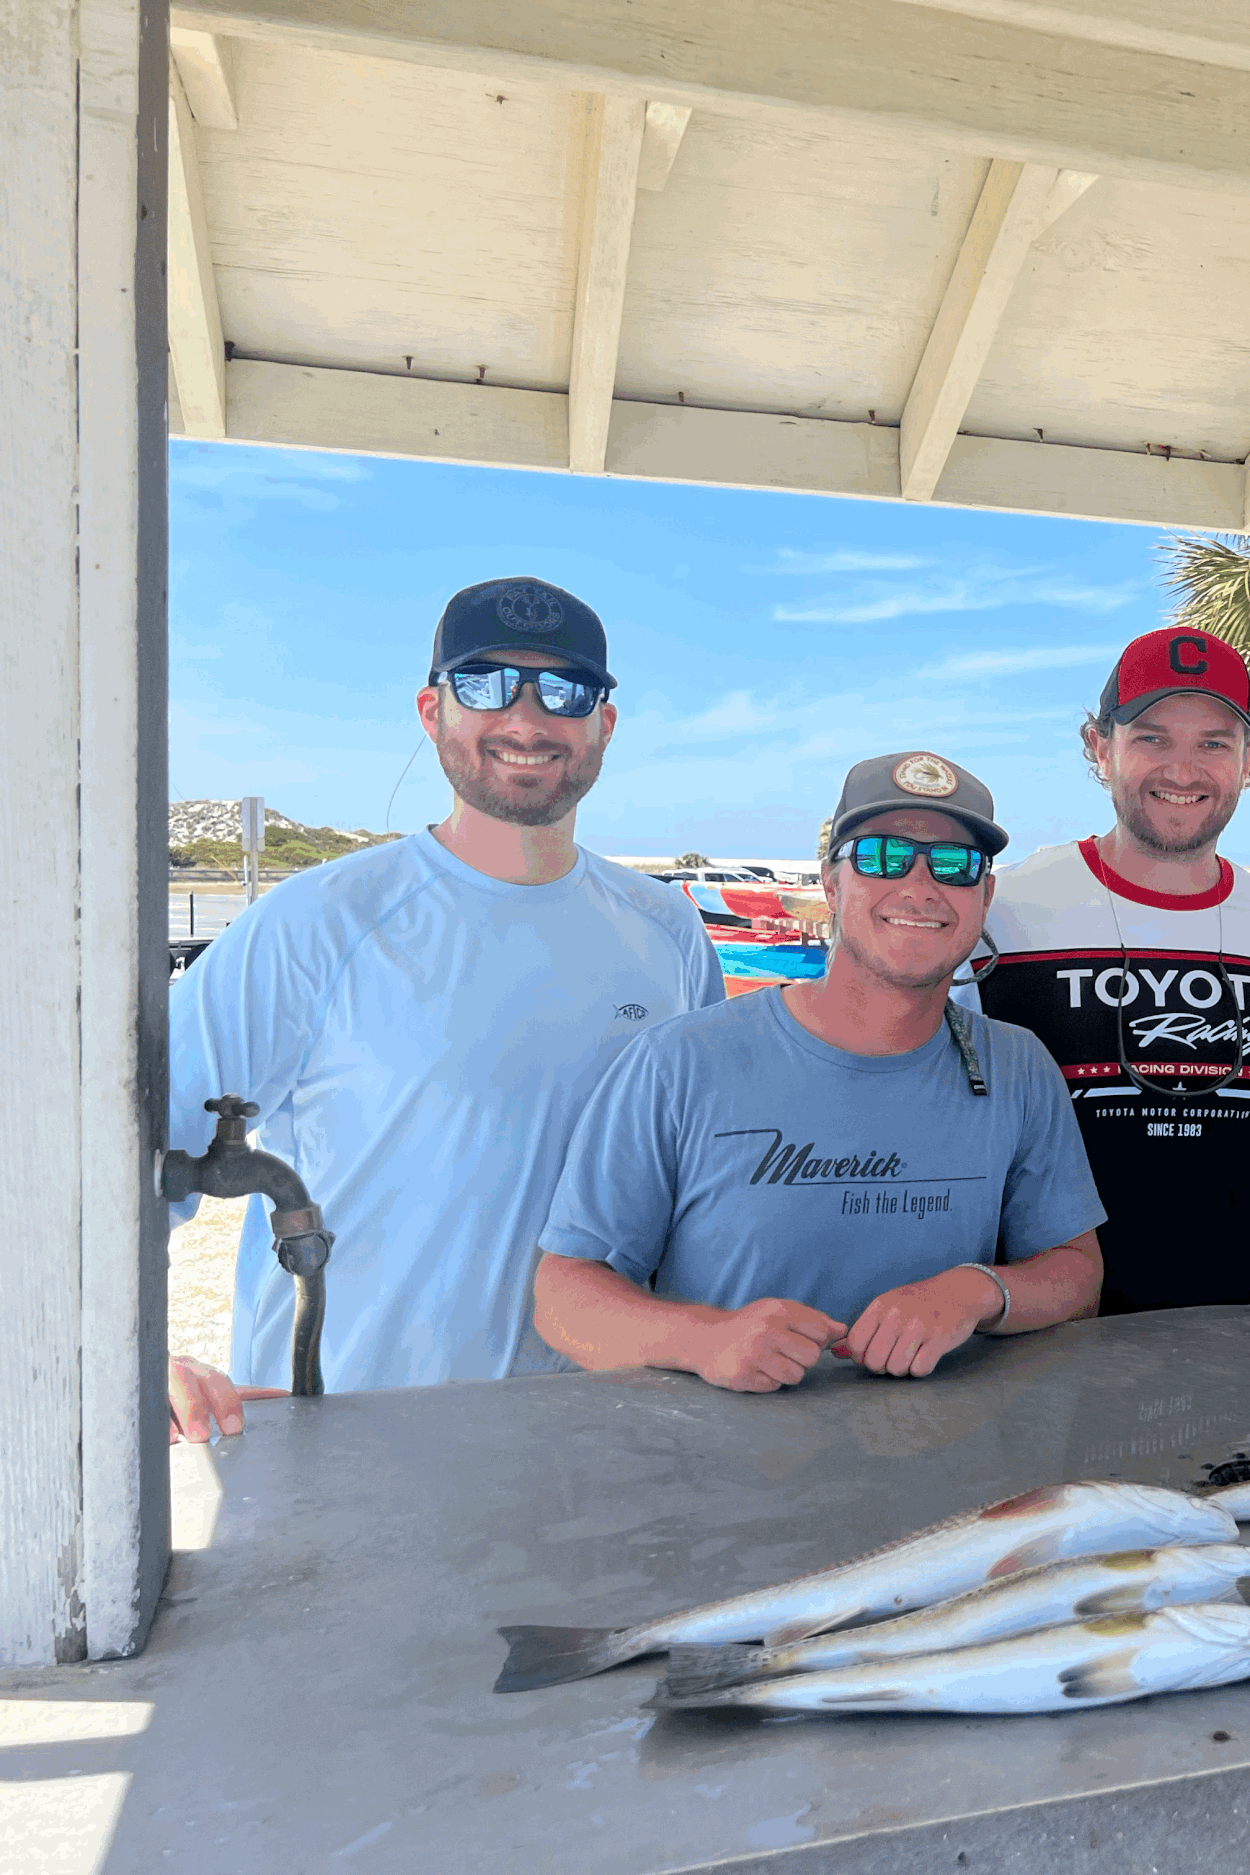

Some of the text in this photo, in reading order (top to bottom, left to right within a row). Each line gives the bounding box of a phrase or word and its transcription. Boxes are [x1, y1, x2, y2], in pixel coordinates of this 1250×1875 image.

[1168, 635, 1208, 674] C
[899, 763, 911, 779] STAND
[910, 756, 924, 764] FOR
[926, 757, 939, 765] THE
[904, 781, 917, 789] YOU
[1117, 1064, 1175, 1075] ACING
[1096, 1107, 1135, 1118] TOYOTA
[1142, 1107, 1177, 1117] MOTOR
[1147, 1123, 1202, 1137] SINCE 1983
[714, 1128, 903, 1186] Maverick
[841, 1189, 870, 1215] Fish
[876, 1190, 897, 1214] the
